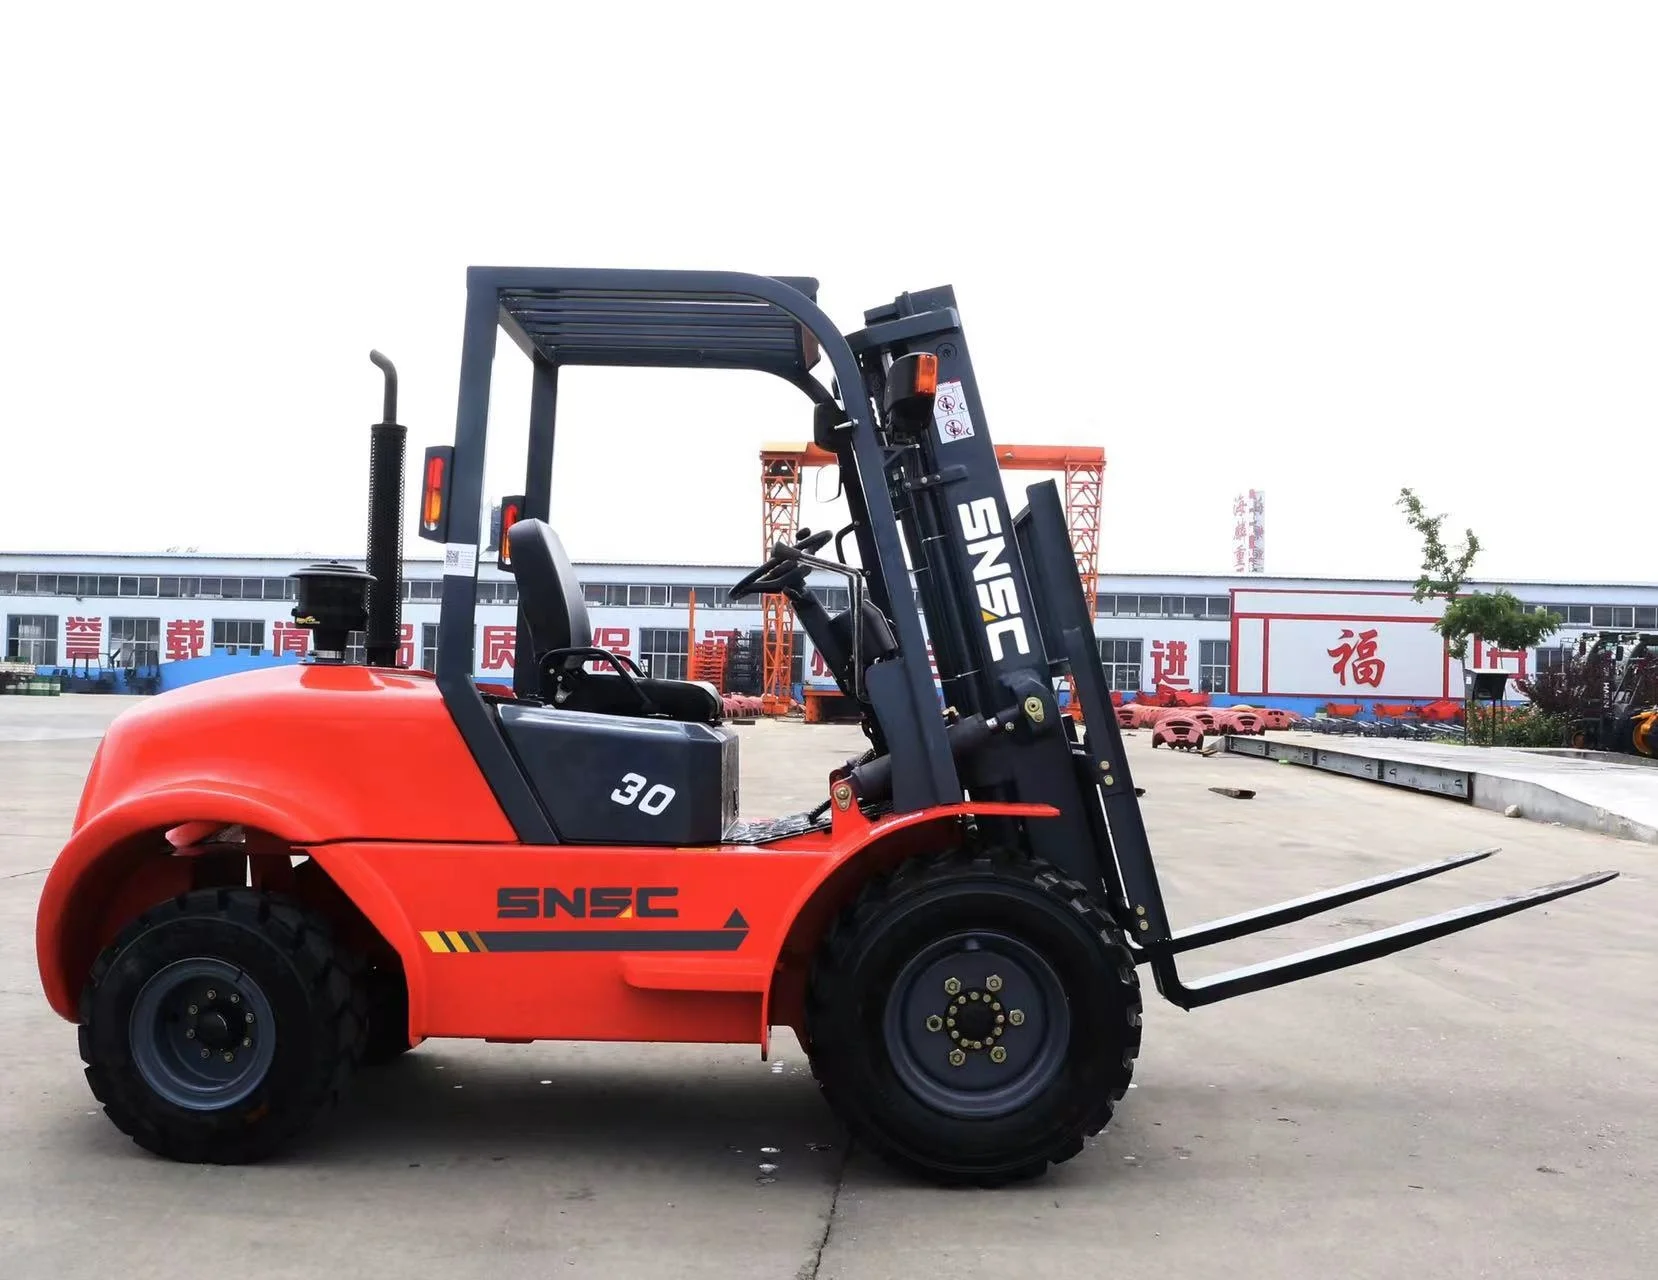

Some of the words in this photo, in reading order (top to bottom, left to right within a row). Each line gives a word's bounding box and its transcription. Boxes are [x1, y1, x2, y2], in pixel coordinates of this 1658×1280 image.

[958, 497, 1029, 661] SNSC
[66, 616, 102, 659] 誉
[166, 619, 204, 661] 载
[1150, 640, 1189, 685] 进
[1327, 629, 1385, 688] 福
[611, 772, 676, 816] 30
[496, 887, 679, 919] SNSC
